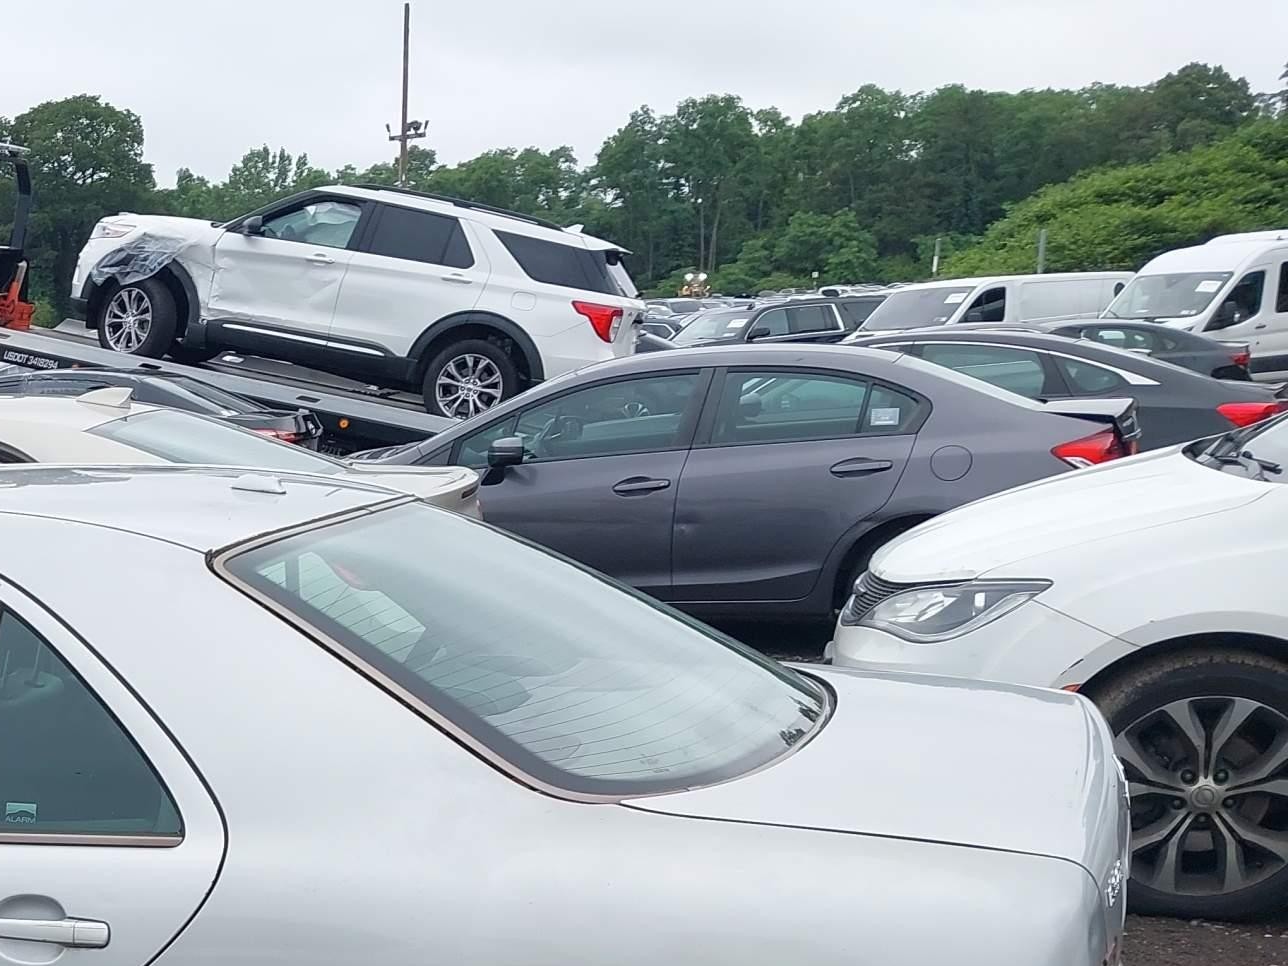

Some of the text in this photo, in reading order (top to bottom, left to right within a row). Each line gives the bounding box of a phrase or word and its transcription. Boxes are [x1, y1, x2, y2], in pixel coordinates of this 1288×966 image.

[3, 350, 58, 369] USDOT 3418294
[5, 815, 37, 824] ALARM
